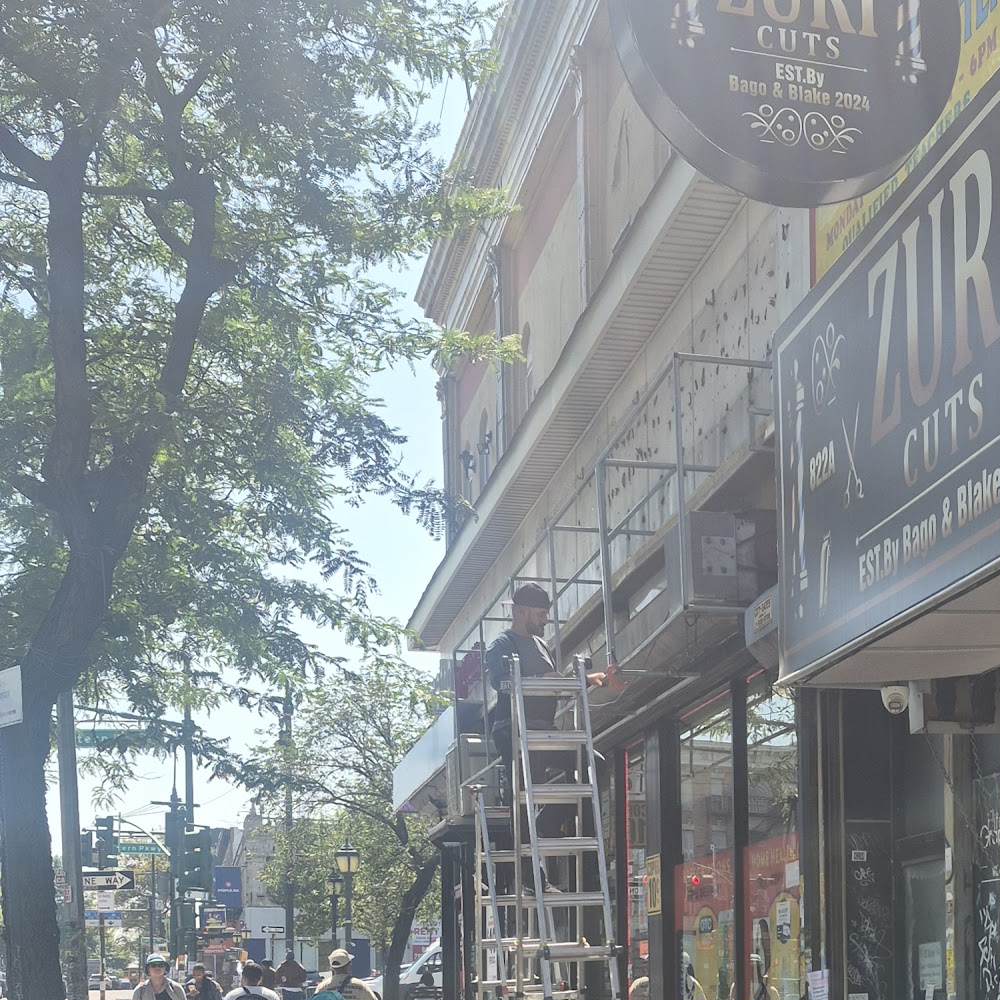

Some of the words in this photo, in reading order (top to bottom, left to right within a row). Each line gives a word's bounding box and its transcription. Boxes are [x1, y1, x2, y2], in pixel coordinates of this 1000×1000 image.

[757, 25, 841, 60] CUTS
[728, 74, 768, 97] Bago
[772, 81, 784, 99] &
[788, 86, 831, 107] Blake
[835, 91, 871, 112] 2024
[775, 62, 825, 89] EST.By
[903, 373, 984, 487] CUTS
[809, 440, 836, 492] 822A
[858, 535, 900, 592] EST.By
[902, 513, 937, 565] Bago
[941, 496, 953, 538] &
[138, 845, 161, 853] Pkwy
[84, 877, 97, 885] NE
[105, 876, 125, 885] WAY
